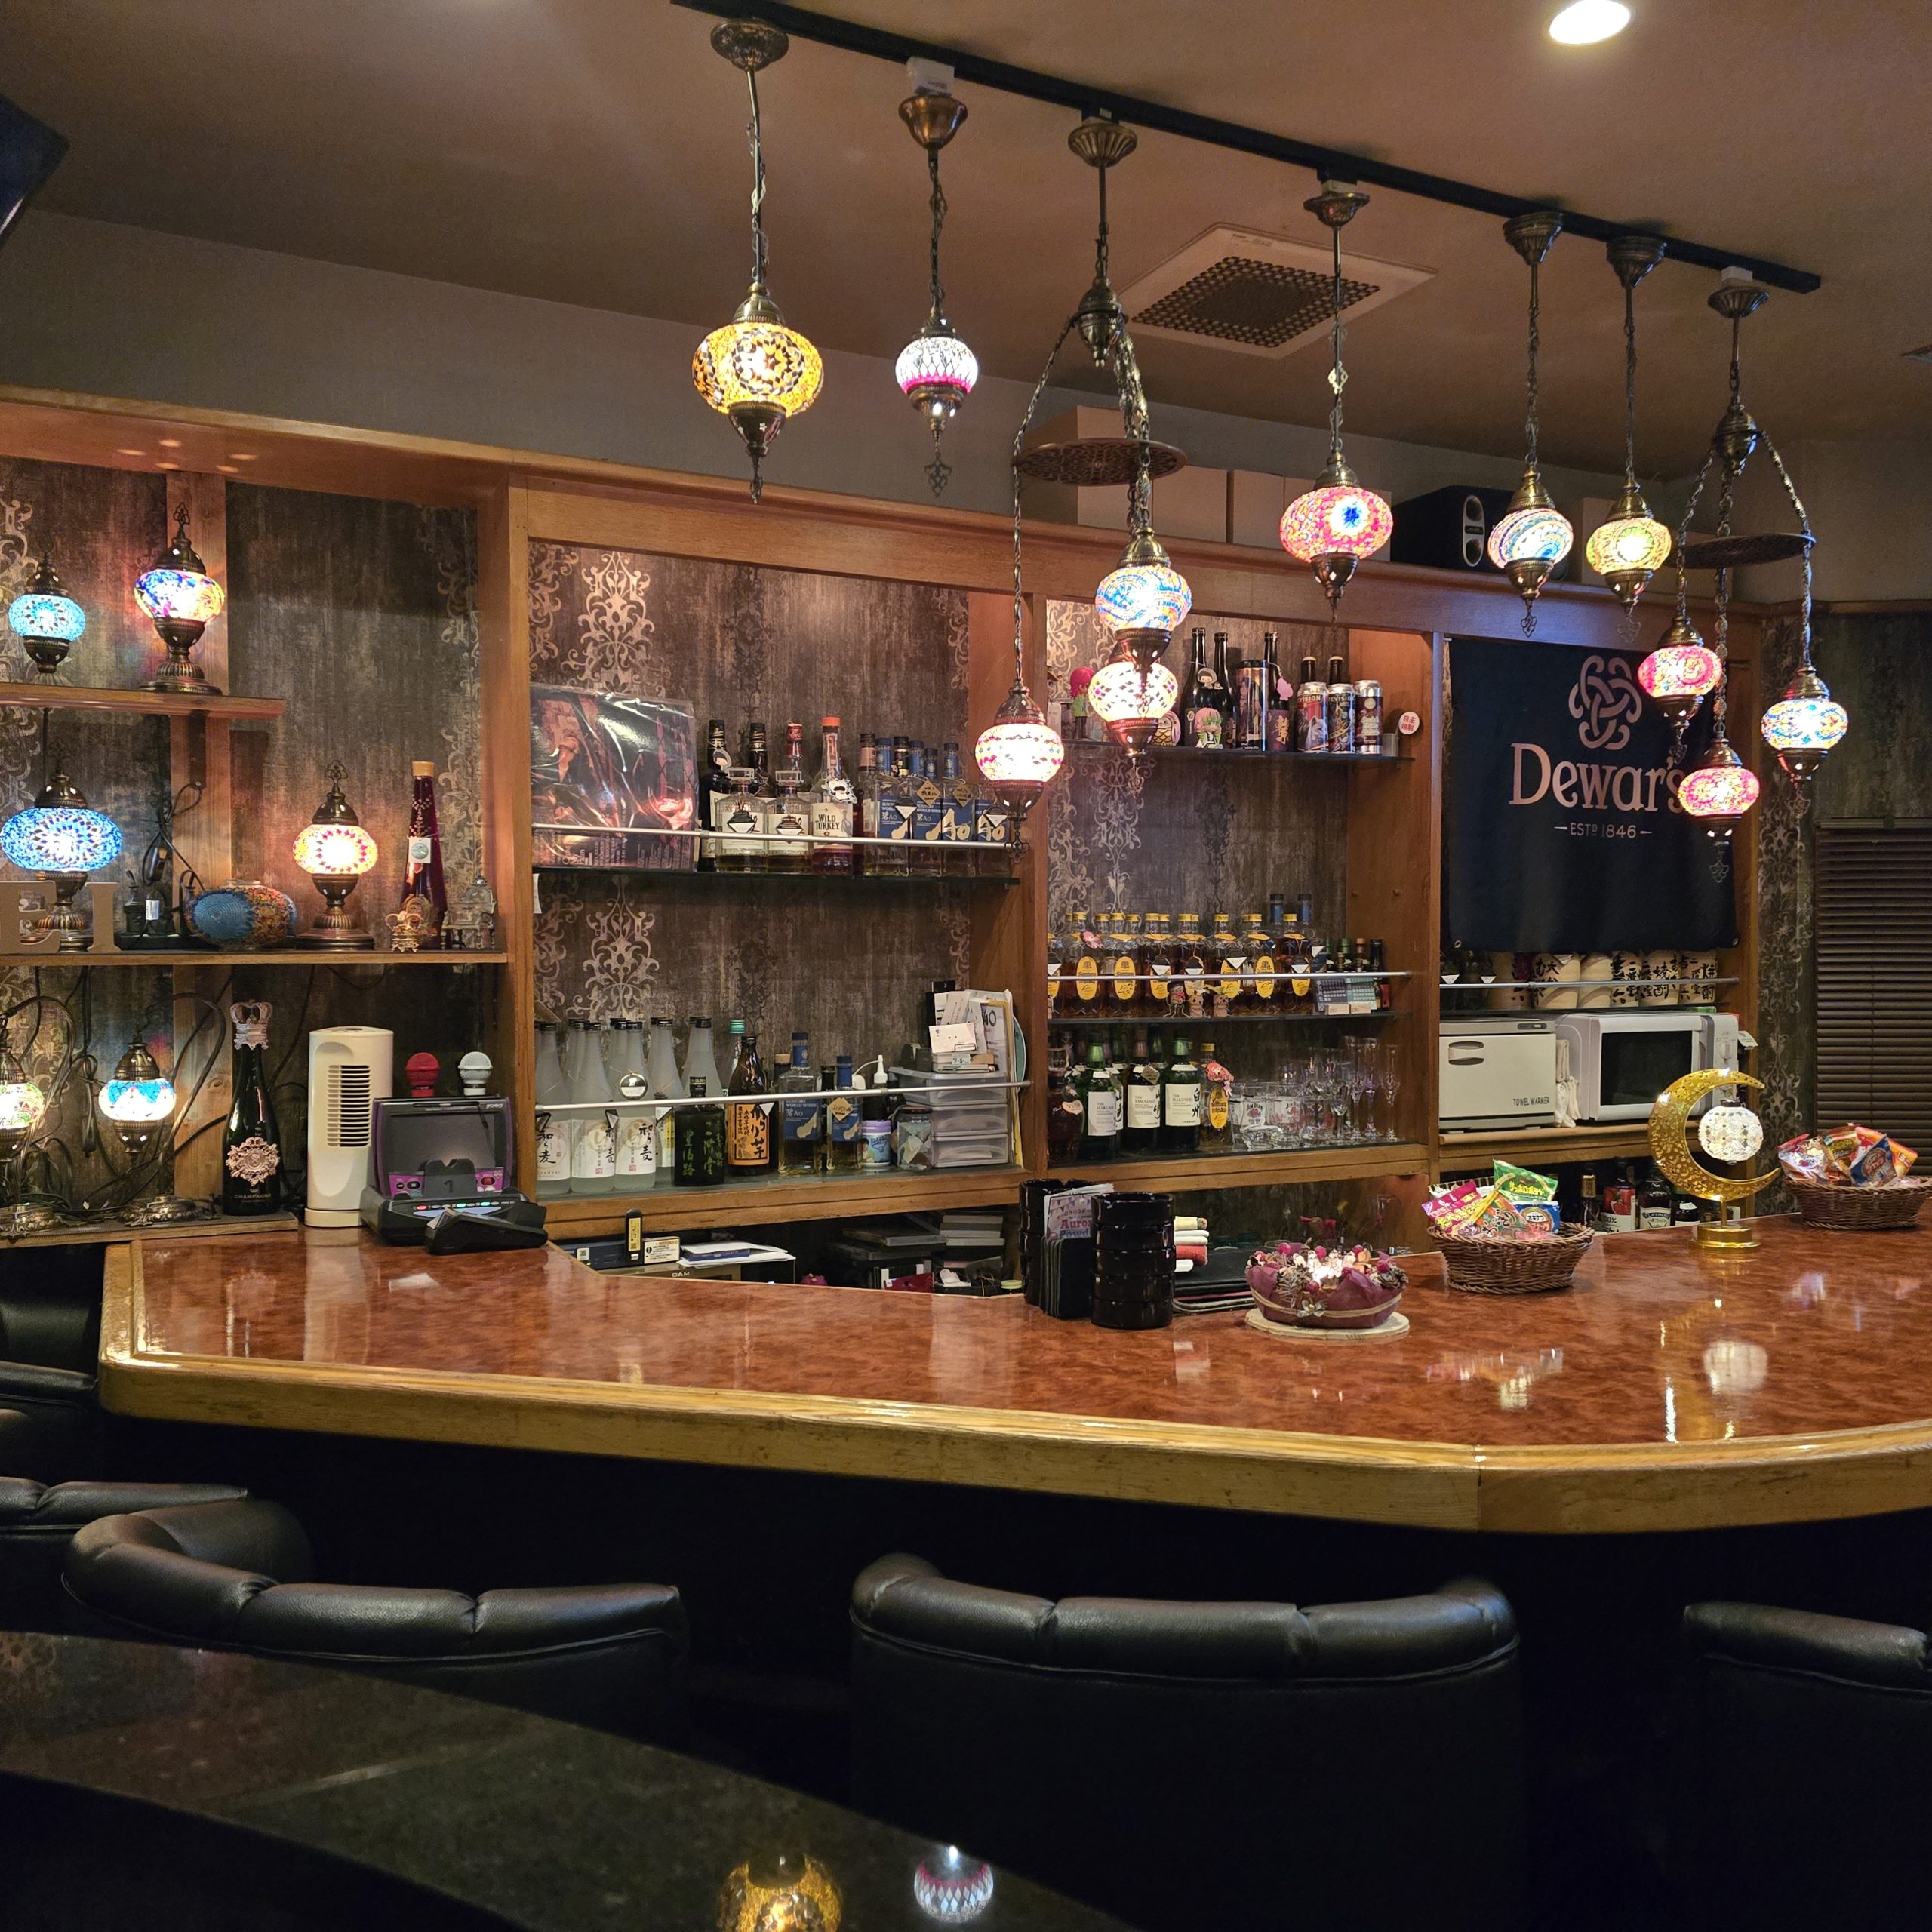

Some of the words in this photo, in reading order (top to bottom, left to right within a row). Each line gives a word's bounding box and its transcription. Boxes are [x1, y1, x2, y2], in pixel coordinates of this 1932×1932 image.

[1509, 743, 1684, 813] Dewar's
[815, 821, 840, 830] TURKEY
[1601, 824, 1637, 839] 1846
[1513, 1097, 1531, 1106] TOWEL
[1531, 1097, 1550, 1106] WARMER
[1059, 1228, 1089, 1238] Powd
